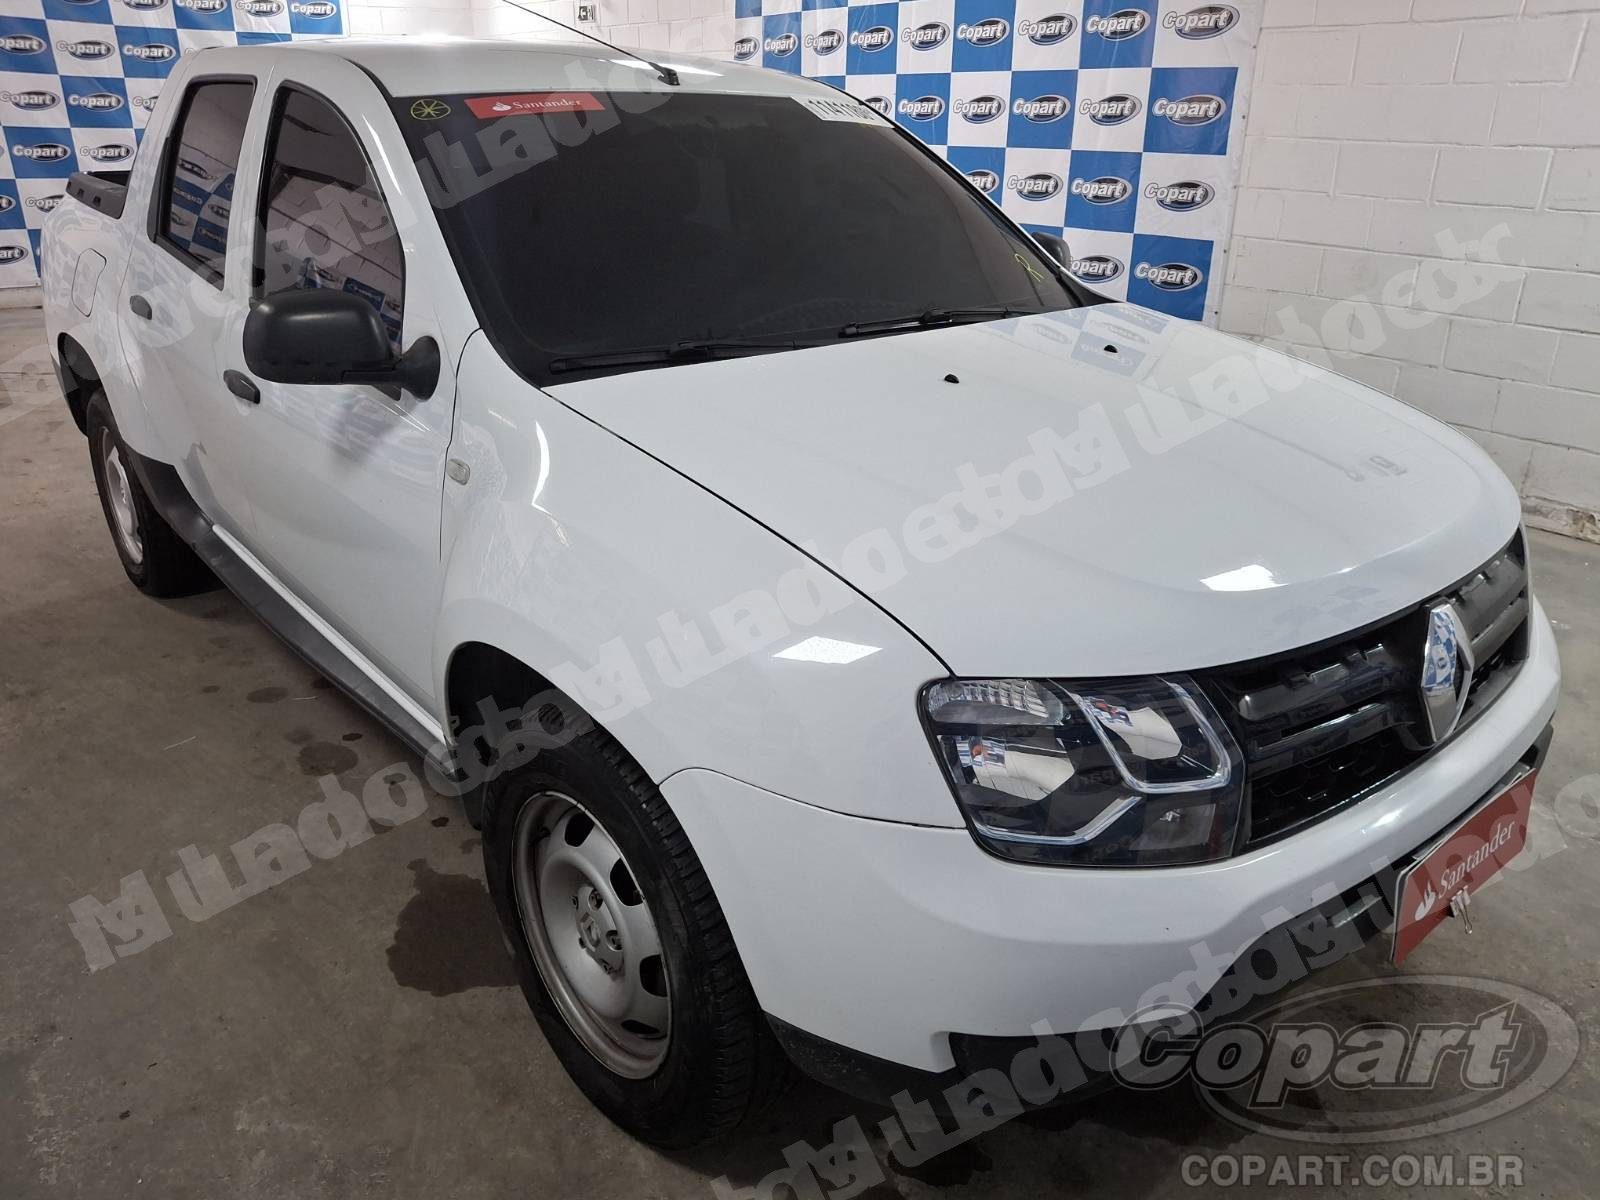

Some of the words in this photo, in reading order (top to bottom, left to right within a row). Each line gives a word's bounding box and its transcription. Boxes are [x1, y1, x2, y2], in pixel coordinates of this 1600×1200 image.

[235, 1, 278, 14] Copart
[291, 3, 333, 15] Copart
[1018, 17, 1071, 40] Copart
[1085, 13, 1144, 36] Copart
[1162, 10, 1229, 32] Copart
[850, 28, 888, 46] Copart
[901, 26, 943, 45] Copart
[956, 21, 1004, 41] Copart
[0, 38, 39, 50] opart
[56, 40, 107, 55] Copart
[123, 44, 170, 58] Copart
[734, 42, 755, 55] part
[764, 36, 793, 52] Copart
[803, 33, 839, 50] Copart
[0, 91, 51, 106] Copart
[69, 94, 118, 108] Copart
[512, 97, 583, 111] Santander
[898, 95, 940, 115] Copart
[953, 98, 1000, 118] Copart
[1013, 97, 1065, 118] Copart
[1079, 96, 1135, 118] Copart
[1152, 96, 1219, 120] Copart
[13, 144, 64, 158] Copart
[80, 145, 126, 158] Copart
[1007, 174, 1057, 195] Copart
[1071, 177, 1124, 198] Copart
[1144, 181, 1205, 204] Copart
[1069, 259, 1115, 278] opart
[1135, 261, 1194, 286] Copart
[1438, 821, 1515, 899] Santander
